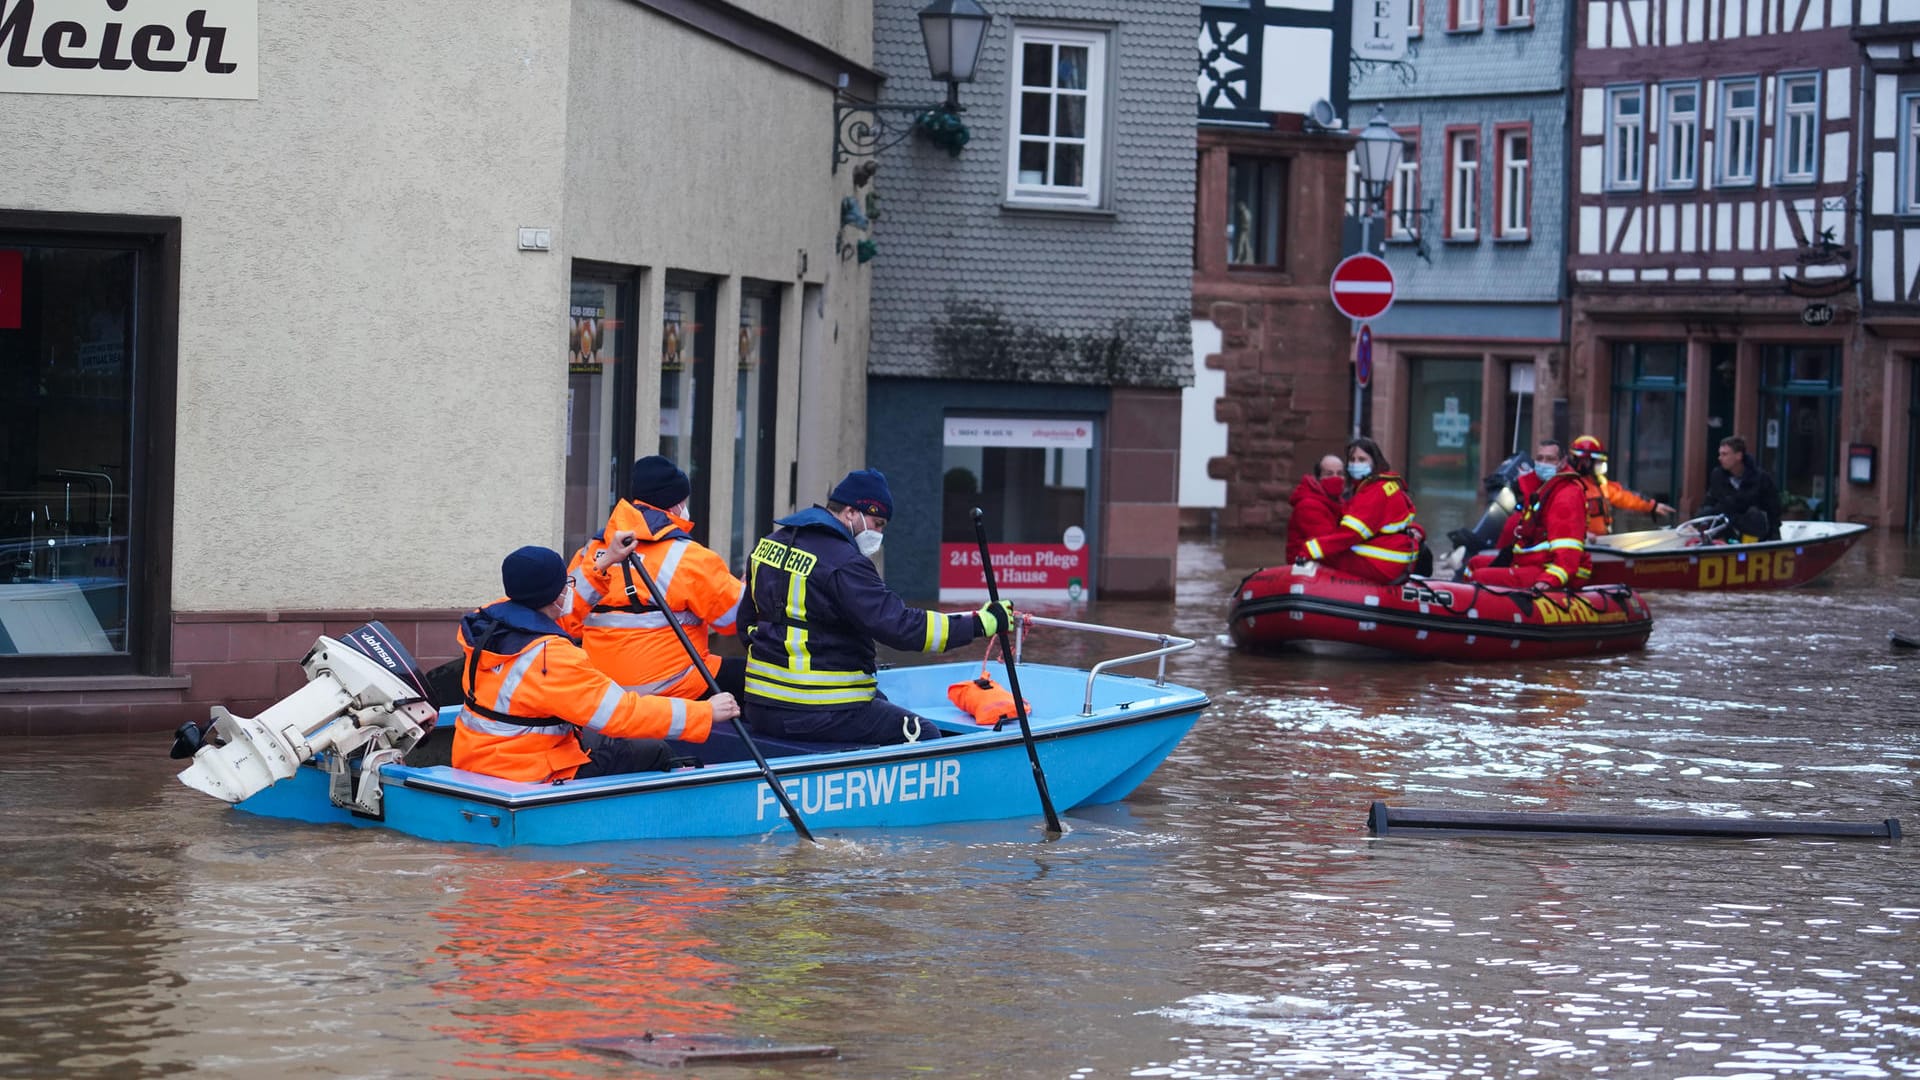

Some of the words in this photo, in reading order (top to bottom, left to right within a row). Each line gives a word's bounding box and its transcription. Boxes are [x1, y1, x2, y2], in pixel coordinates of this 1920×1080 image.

[755, 541, 813, 574] FEUEREHR
[951, 550, 968, 566] 24
[971, 550, 1032, 566] Sunden
[1035, 551, 1078, 569] Pflege
[1699, 551, 1796, 588] DLRG
[1003, 568, 1048, 583] Hause
[361, 632, 397, 668] Johnson
[757, 759, 961, 821] FEUERWEHR
